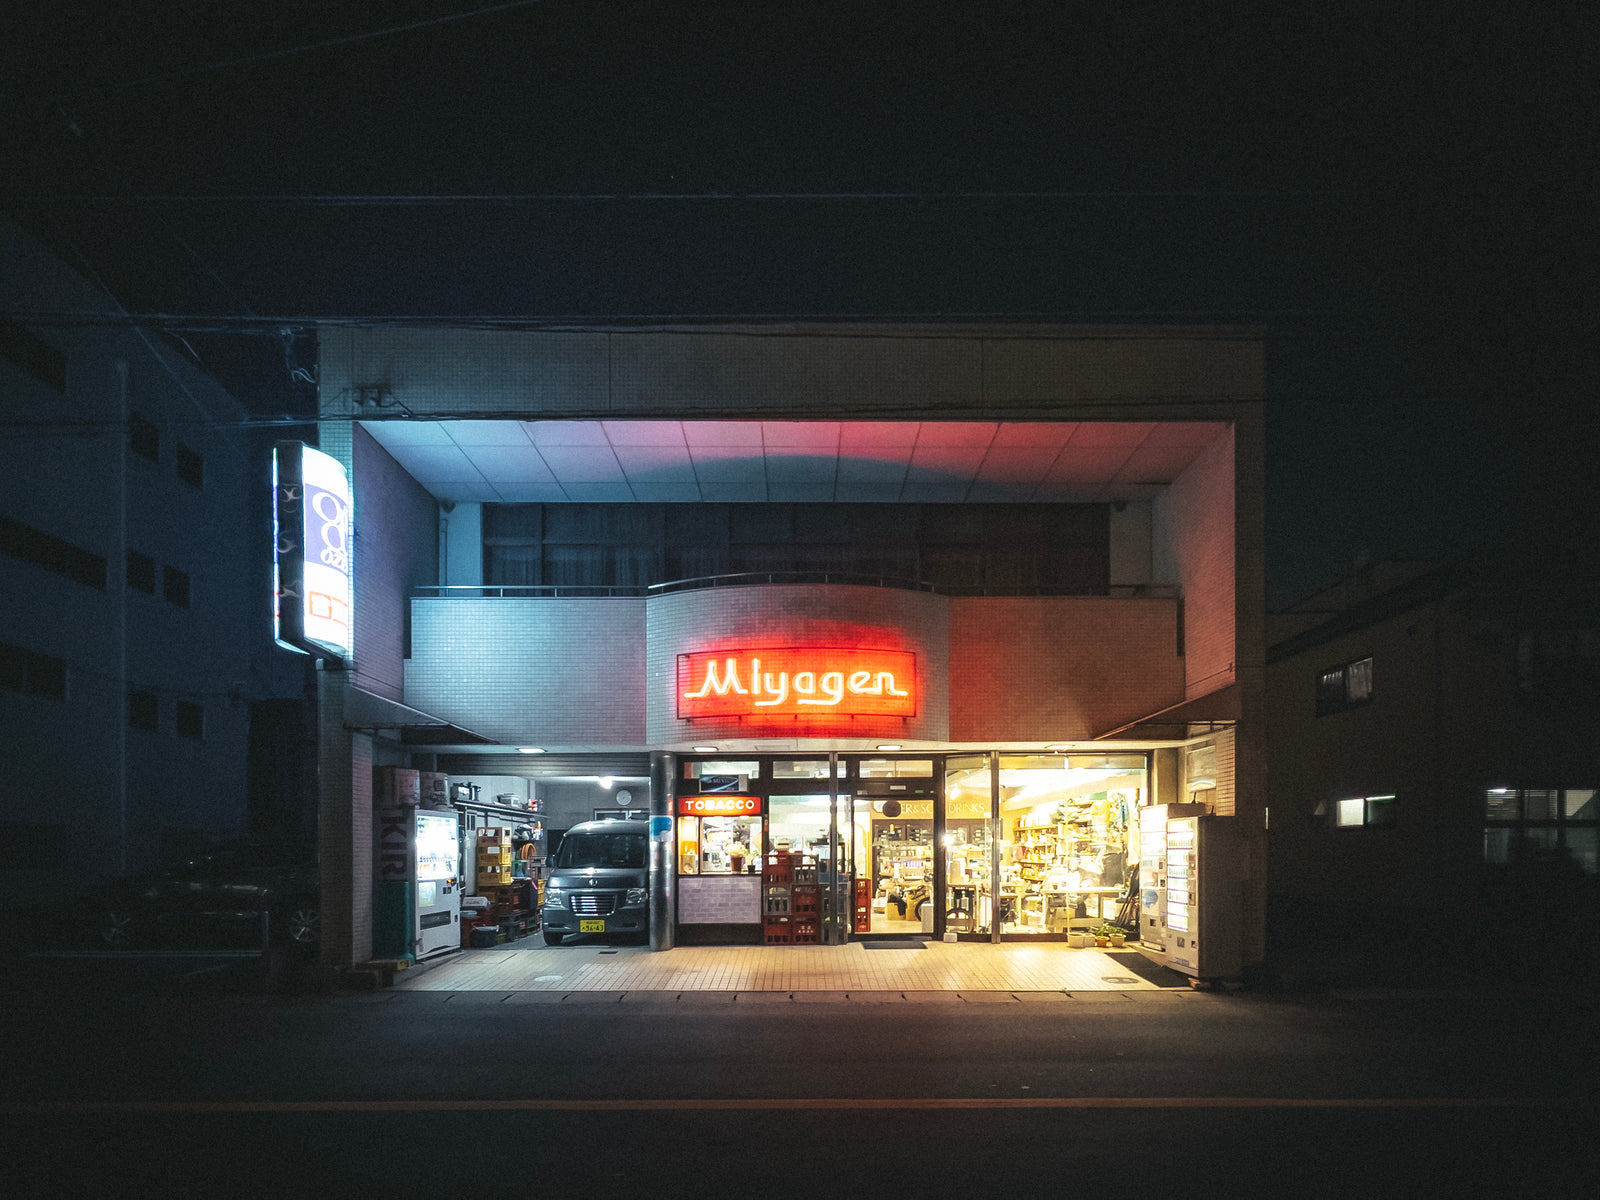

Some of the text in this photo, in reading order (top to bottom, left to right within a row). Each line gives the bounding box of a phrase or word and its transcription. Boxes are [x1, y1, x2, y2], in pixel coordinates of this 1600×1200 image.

[685, 799, 755, 811] TOBACCO
[900, 804, 913, 814] ER
[948, 802, 985, 814] DRINKS
[381, 816, 408, 876] KIR
